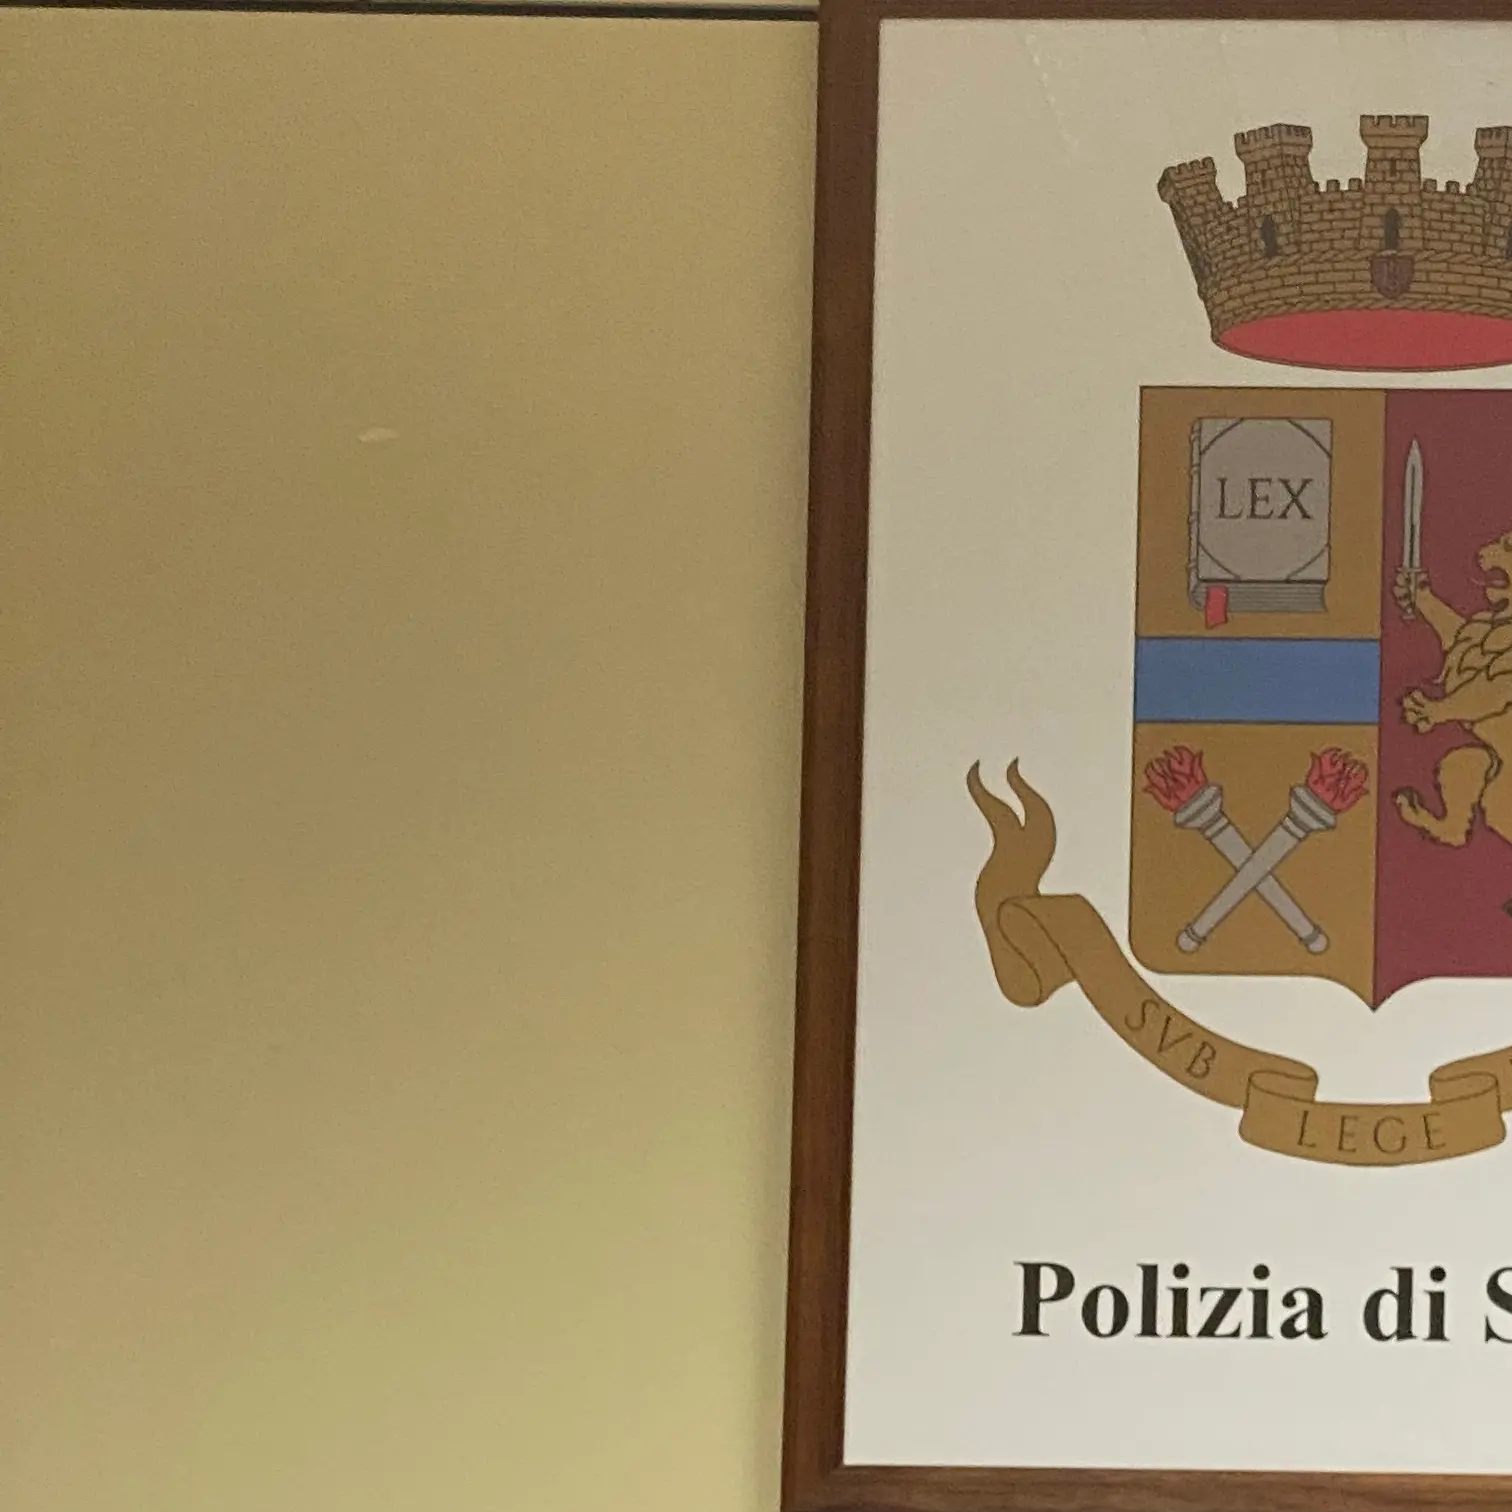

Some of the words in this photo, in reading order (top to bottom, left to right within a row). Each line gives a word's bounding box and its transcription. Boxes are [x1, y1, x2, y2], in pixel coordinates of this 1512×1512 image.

[1215, 476, 1315, 520] LEX
[1124, 998, 1220, 1081] SVB
[1295, 1109, 1447, 1155] LEGE
[1011, 1259, 1329, 1342] Polizia
[1362, 1265, 1449, 1344] di
